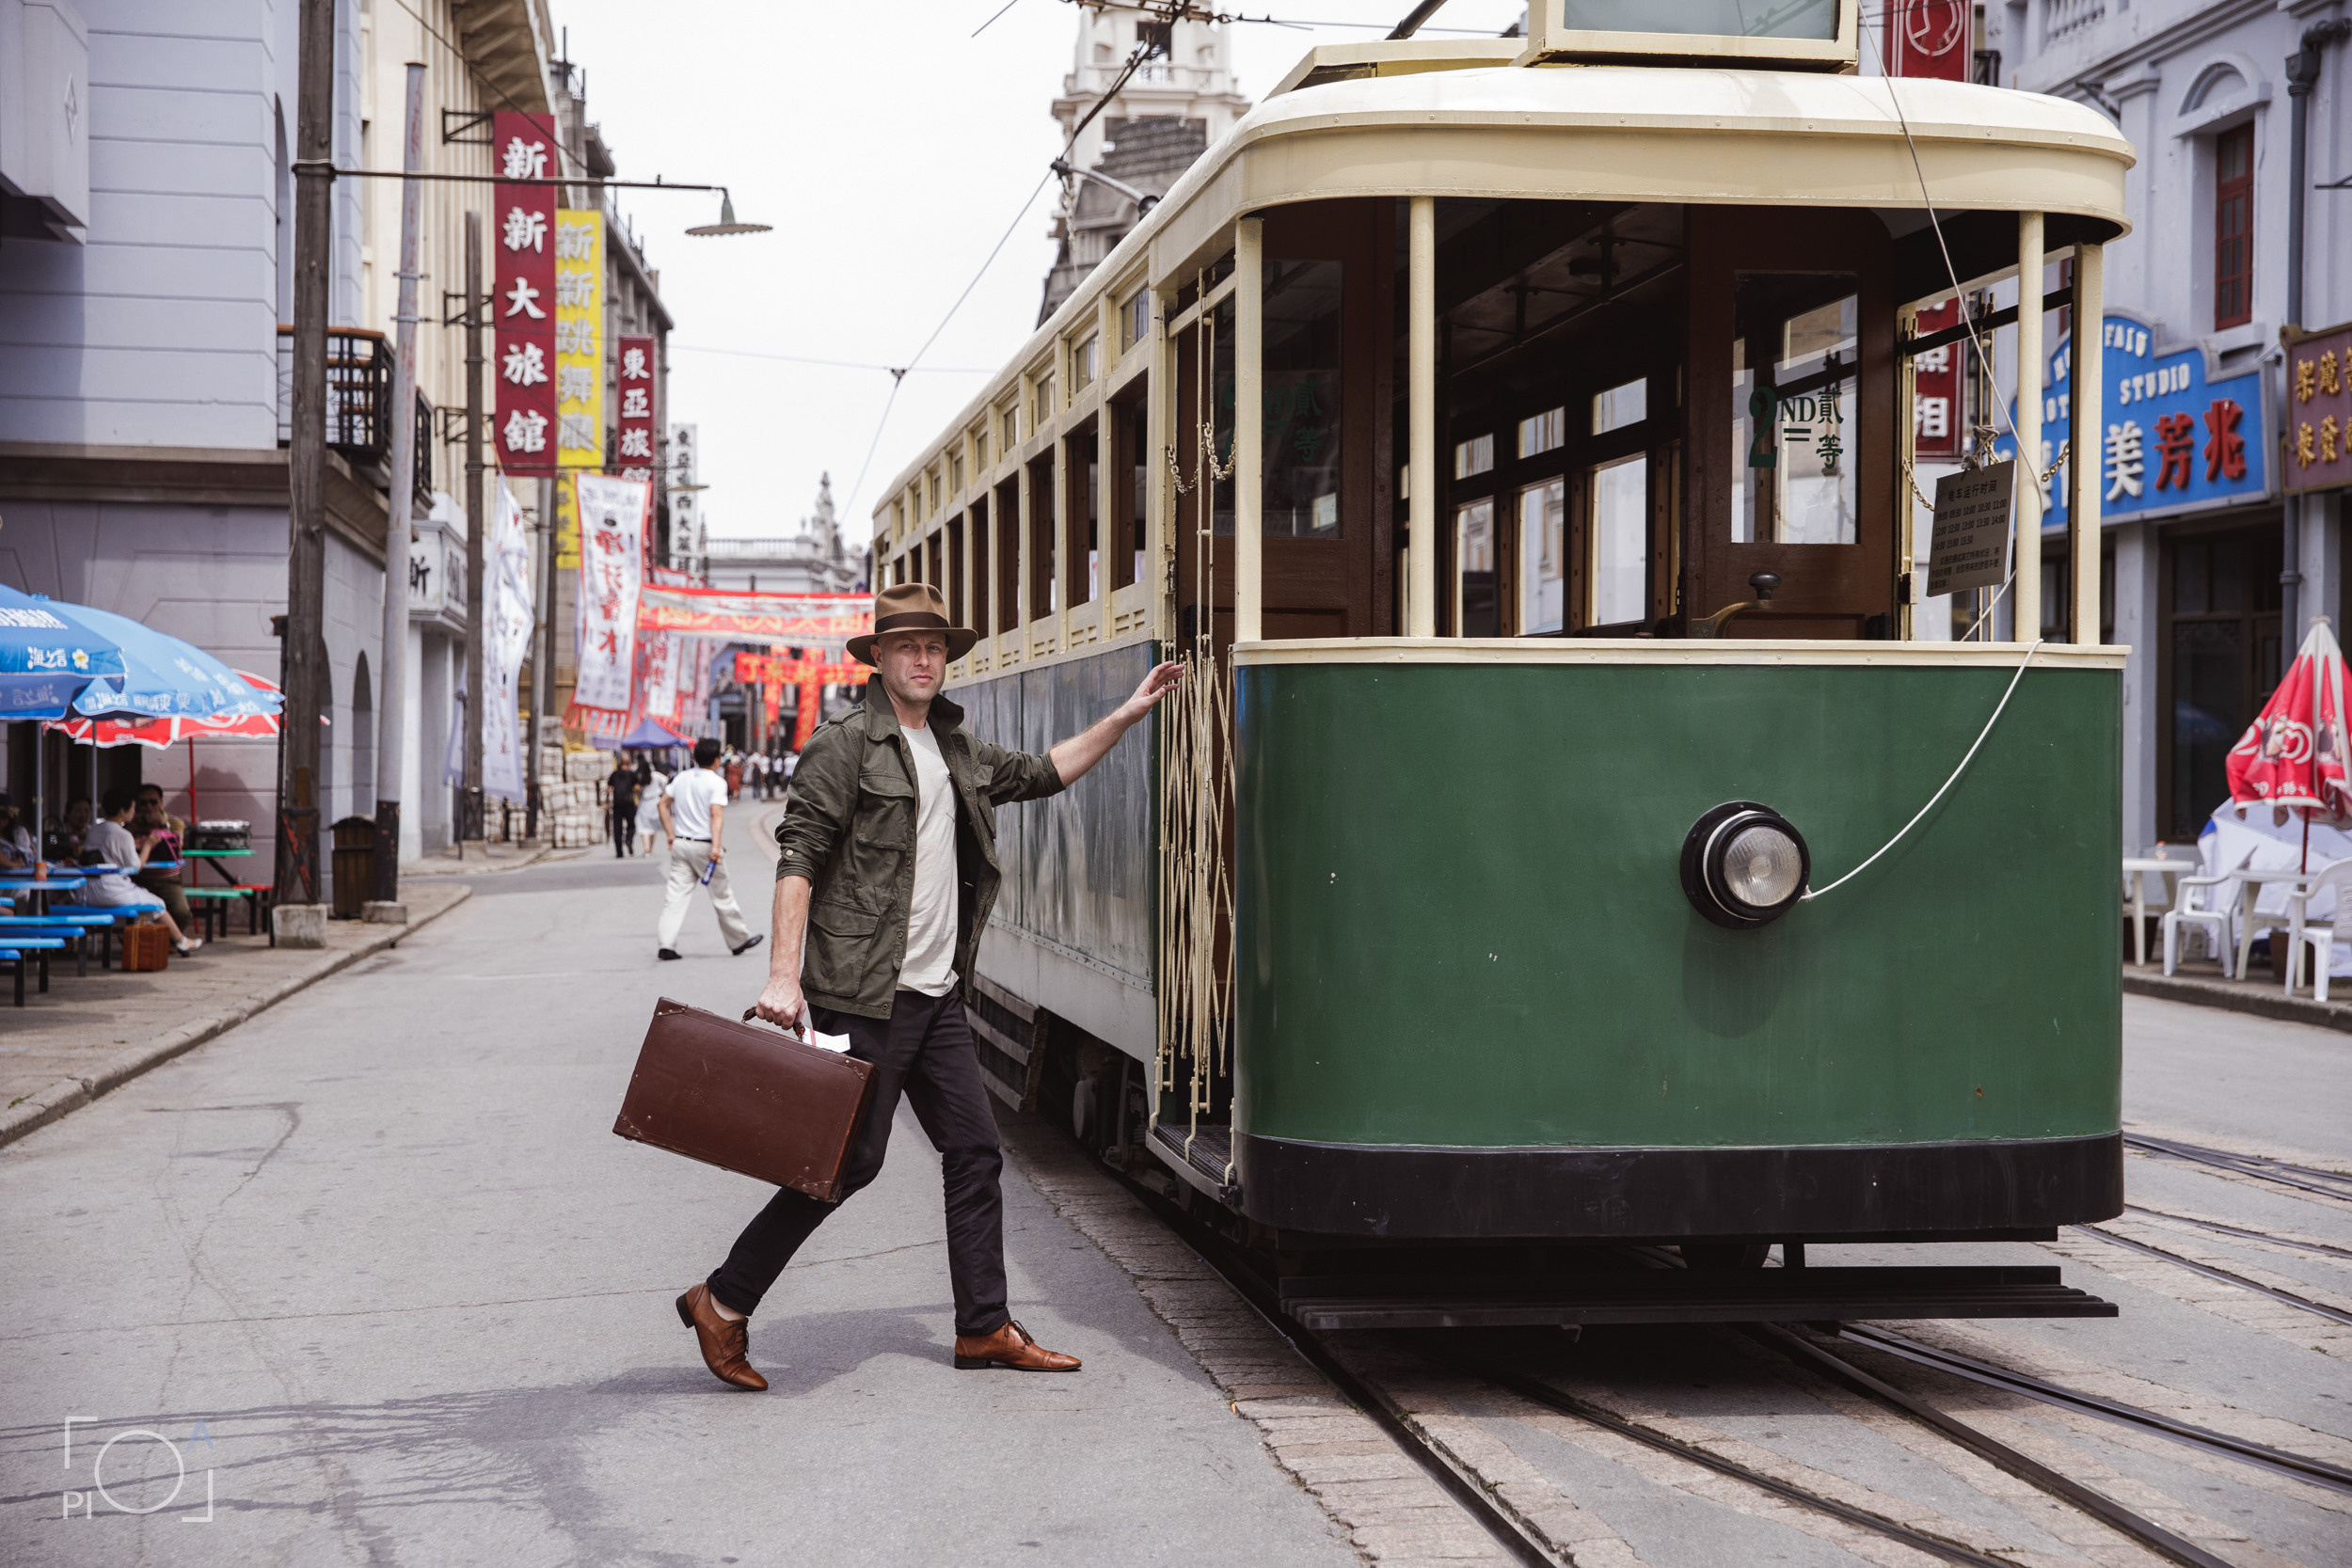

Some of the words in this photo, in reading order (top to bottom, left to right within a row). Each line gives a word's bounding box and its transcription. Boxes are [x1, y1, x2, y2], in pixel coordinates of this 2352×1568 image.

[502, 136, 548, 453] 新新大旅館
[2120, 362, 2190, 405] STUDIO
[1749, 387, 1817, 468] 2ND
[1816, 387, 1844, 469] 貳等
[1948, 480, 1997, 502] 电车运行时间
[1963, 505, 1976, 515] 10:00
[1977, 502, 1992, 513] 10:30
[1993, 499, 2007, 509] 11:00
[1947, 524, 1960, 533] 12:30
[1962, 520, 1975, 531] 13:00
[1976, 517, 1990, 528] 13:30
[1991, 515, 2006, 525] 14:00
[1947, 538, 1960, 548] 15:00
[1960, 535, 1974, 546] 15:30
